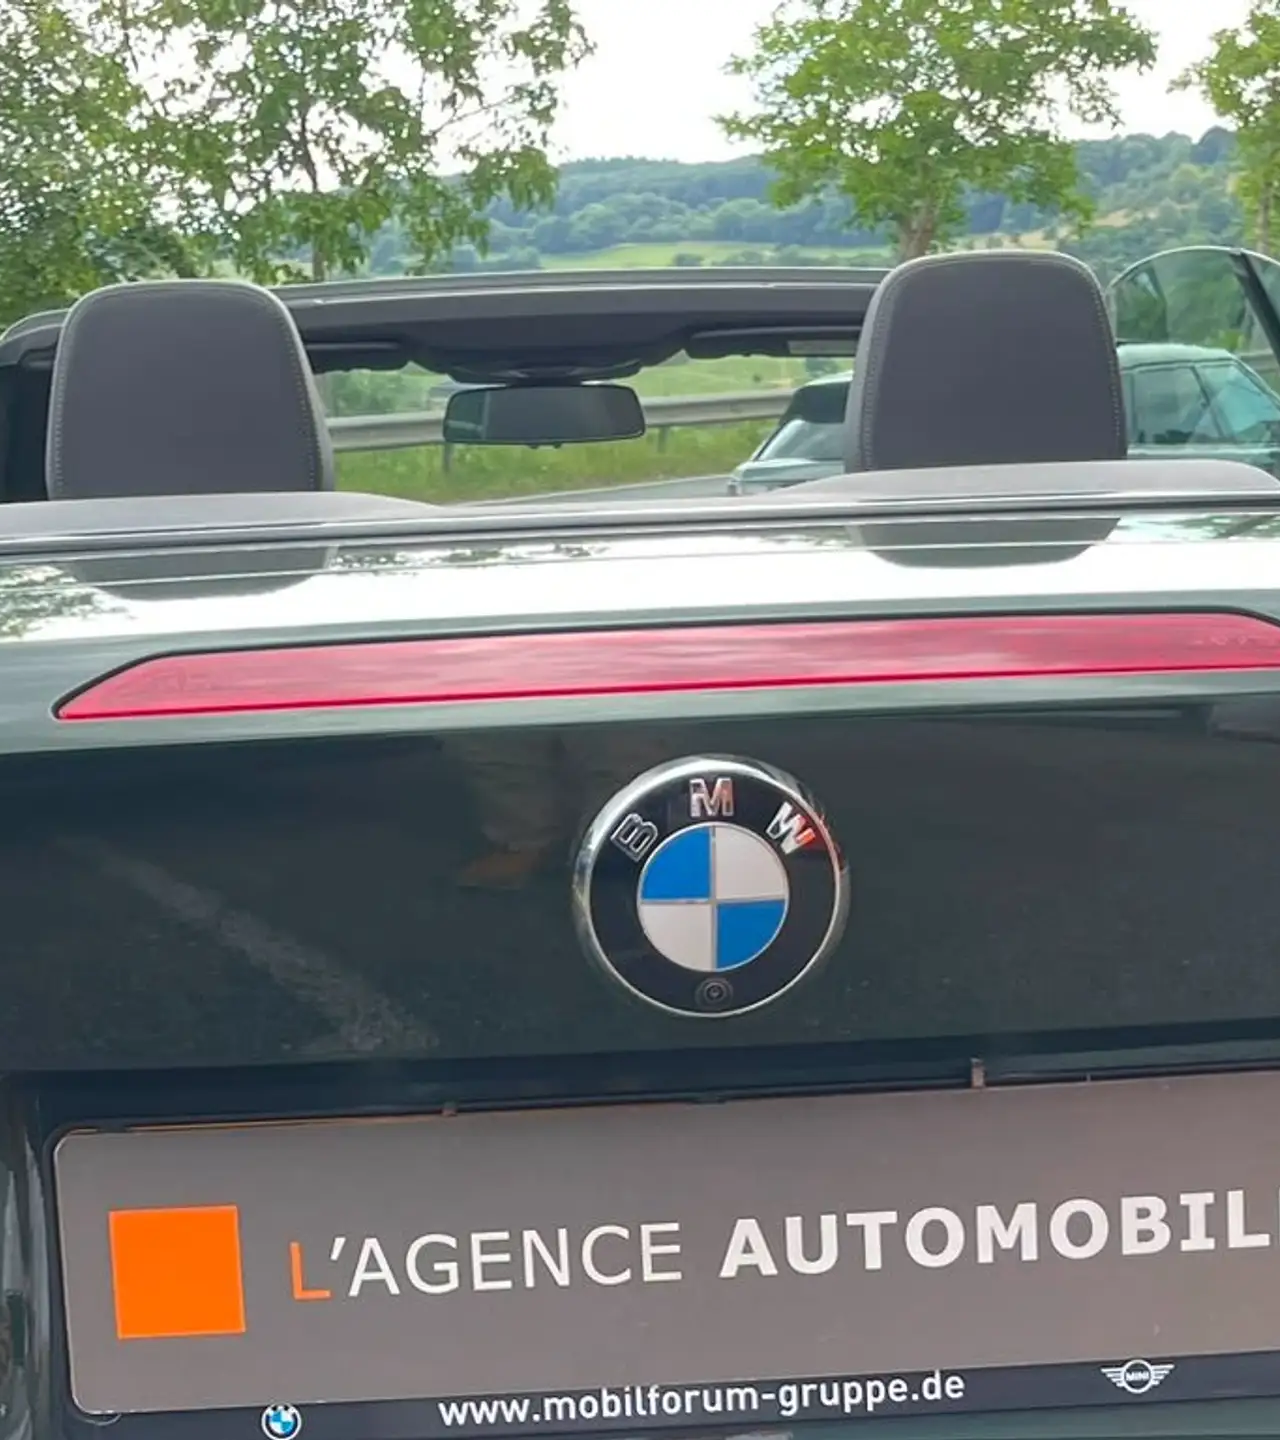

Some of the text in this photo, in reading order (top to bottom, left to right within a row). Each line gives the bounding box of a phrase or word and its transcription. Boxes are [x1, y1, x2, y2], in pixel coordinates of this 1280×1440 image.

[610, 777, 816, 862] BMW
[288, 1221, 683, 1301] L'AGENCE
[437, 1369, 966, 1427] www.mobilforum-gruppe.de
